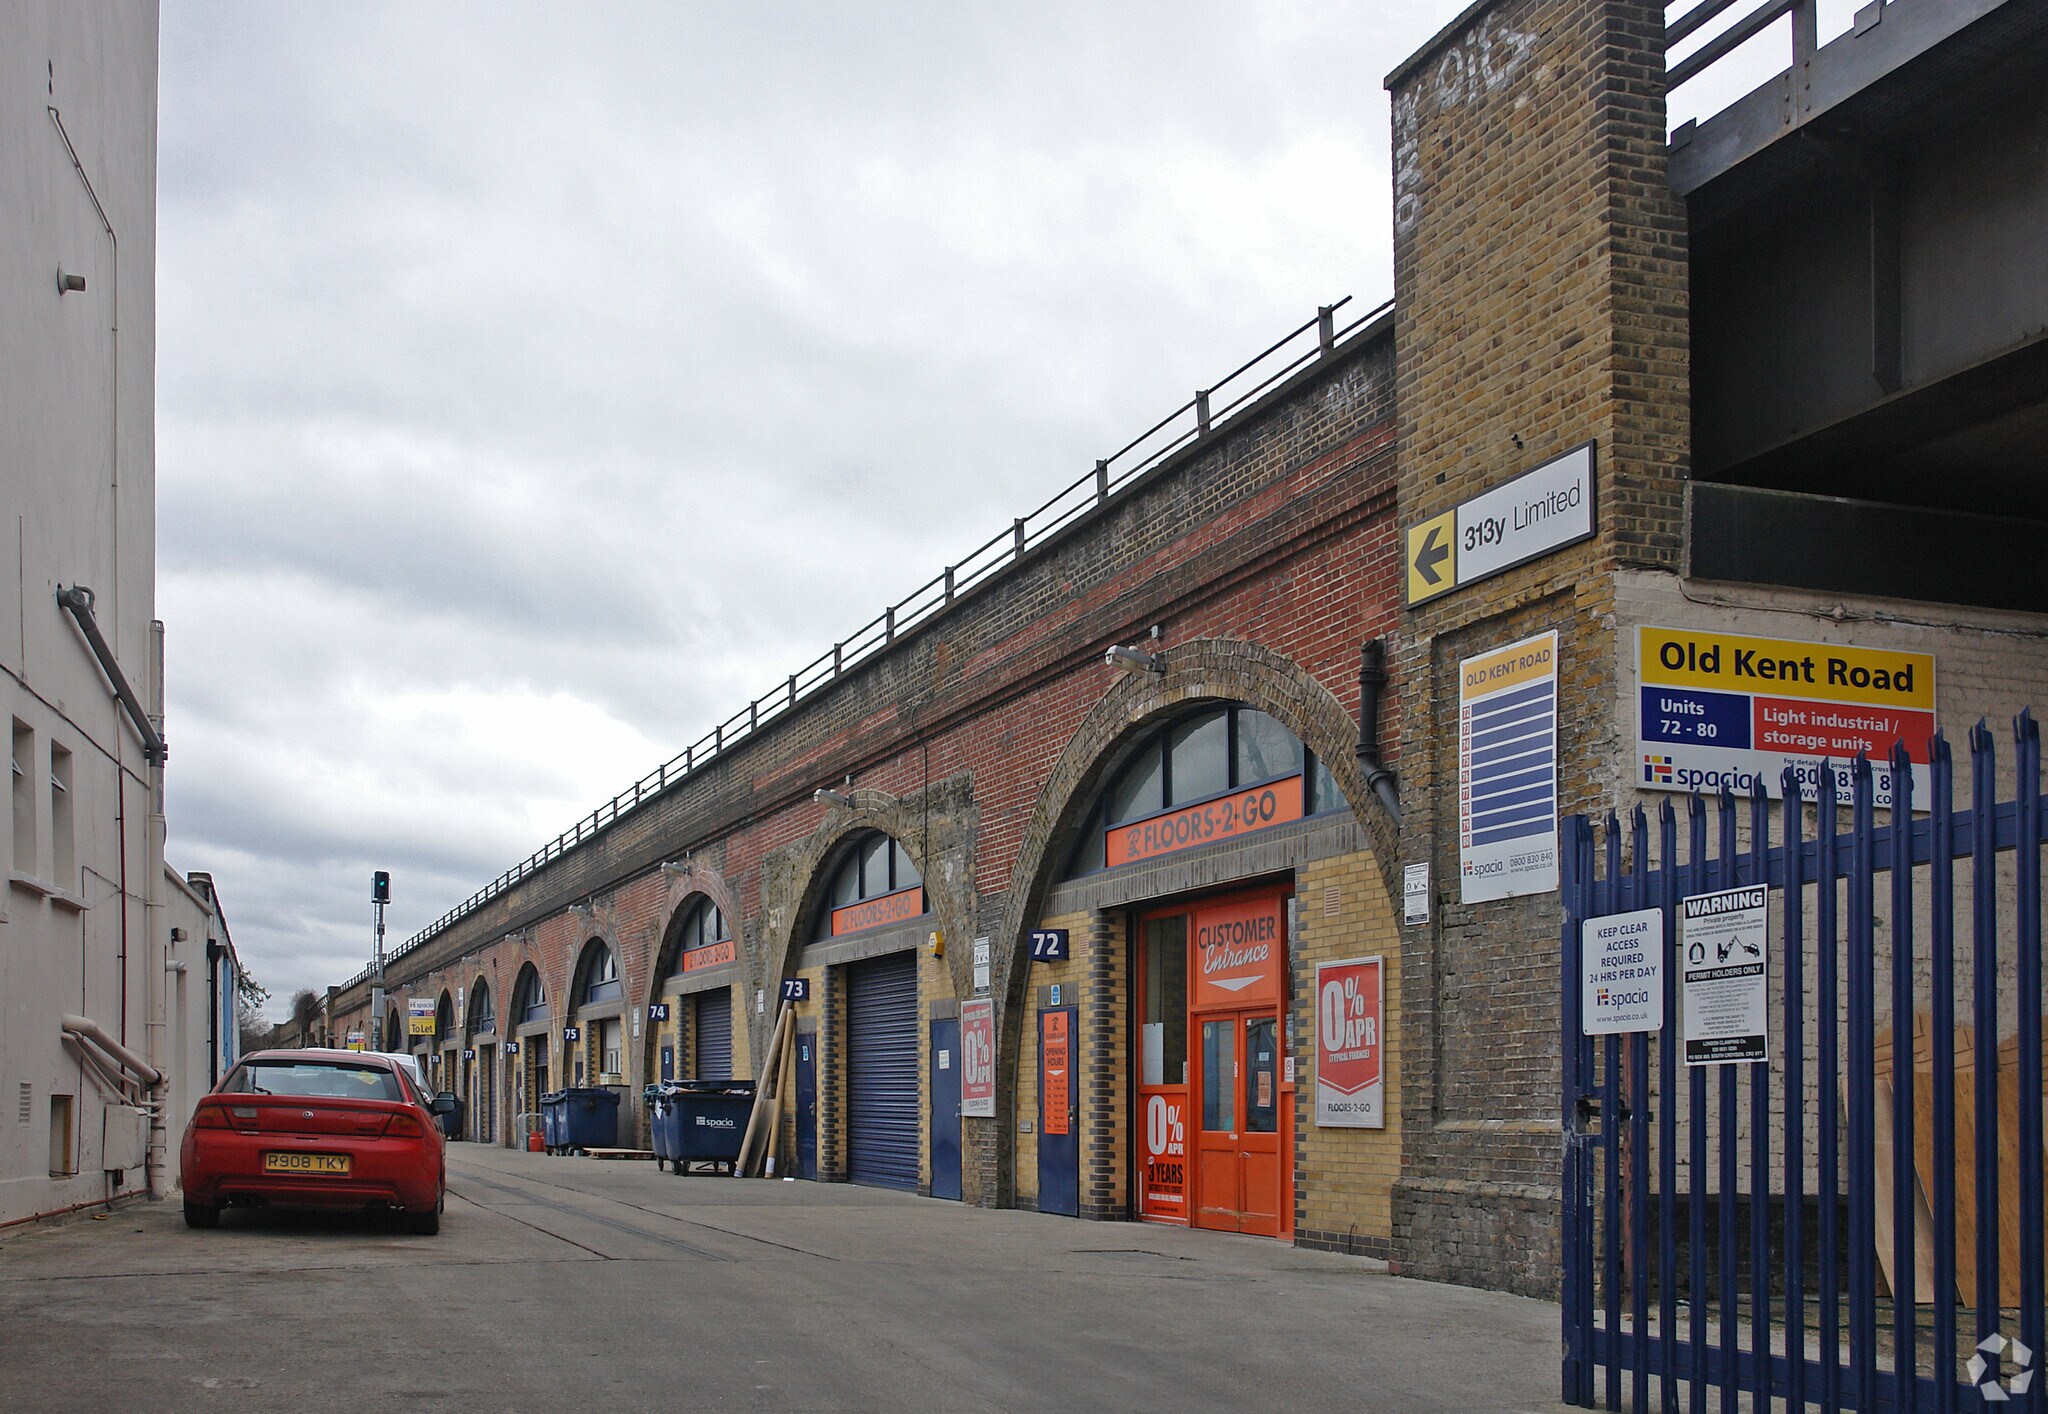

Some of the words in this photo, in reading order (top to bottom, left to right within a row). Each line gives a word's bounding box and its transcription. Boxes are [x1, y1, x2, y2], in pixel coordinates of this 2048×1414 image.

[1464, 516, 1506, 552] 313y
[1514, 478, 1580, 532] Limited
[1466, 670, 1487, 687] OLD
[1489, 660, 1517, 680] KENT
[1519, 649, 1551, 670] ROAD
[1659, 641, 1720, 674] Old
[1734, 649, 1815, 684] Kent
[1827, 657, 1914, 693] Road
[1660, 698, 1705, 716] Units
[1660, 719, 1681, 735] 72
[1696, 722, 1718, 738] 80
[1763, 707, 1806, 726] Light
[1811, 710, 1889, 733] industrial
[1764, 731, 1827, 751] storage
[1831, 734, 1873, 751] units
[1677, 766, 1753, 791] spacia
[1144, 789, 1277, 852] FLOORS-2-GO
[1474, 858, 1503, 879] spacia
[850, 894, 911, 929] FLOORS-2-GO
[1687, 891, 1764, 917] WARNING
[1198, 915, 1276, 950] CUSTOMER
[1597, 926, 1618, 939] KEEP
[1620, 922, 1648, 936] CLEAR
[1032, 933, 1059, 956] 72
[1606, 938, 1639, 952] ACCESS
[1203, 941, 1269, 975] Entrance
[1601, 952, 1644, 968] REQUIRED
[1589, 973, 1598, 984] 24
[1600, 971, 1617, 982] HRS
[1619, 968, 1635, 980] PER
[1637, 965, 1657, 978] DAY
[1688, 970, 1711, 981] PERMIT
[1711, 967, 1742, 978] HOLDERS
[1742, 965, 1761, 975] ONLY
[785, 980, 803, 997] 73
[1611, 987, 1649, 1011] spacia
[650, 1005, 665, 1018] 74
[1322, 975, 1364, 1052] 0%
[1596, 1011, 1649, 1024] www.spacia.co.uk
[411, 1023, 420, 1033] To
[421, 1024, 433, 1033] Let
[565, 1028, 577, 1040] 75
[1345, 1016, 1376, 1049] APR
[464, 1050, 473, 1059] 77
[506, 1043, 517, 1053] 76
[965, 1028, 989, 1085] 0%
[431, 1055, 440, 1063] 78
[977, 1065, 991, 1084] APR
[1327, 1102, 1371, 1113] FLOORS-2-GO
[706, 1117, 734, 1128] spacia
[1147, 1094, 1184, 1155] 0%
[1167, 1142, 1184, 1155] APR
[267, 1154, 311, 1169] R908
[316, 1156, 347, 1170] TKY
[1148, 1163, 1155, 1182] 3
[1155, 1163, 1183, 1185] YEARS
